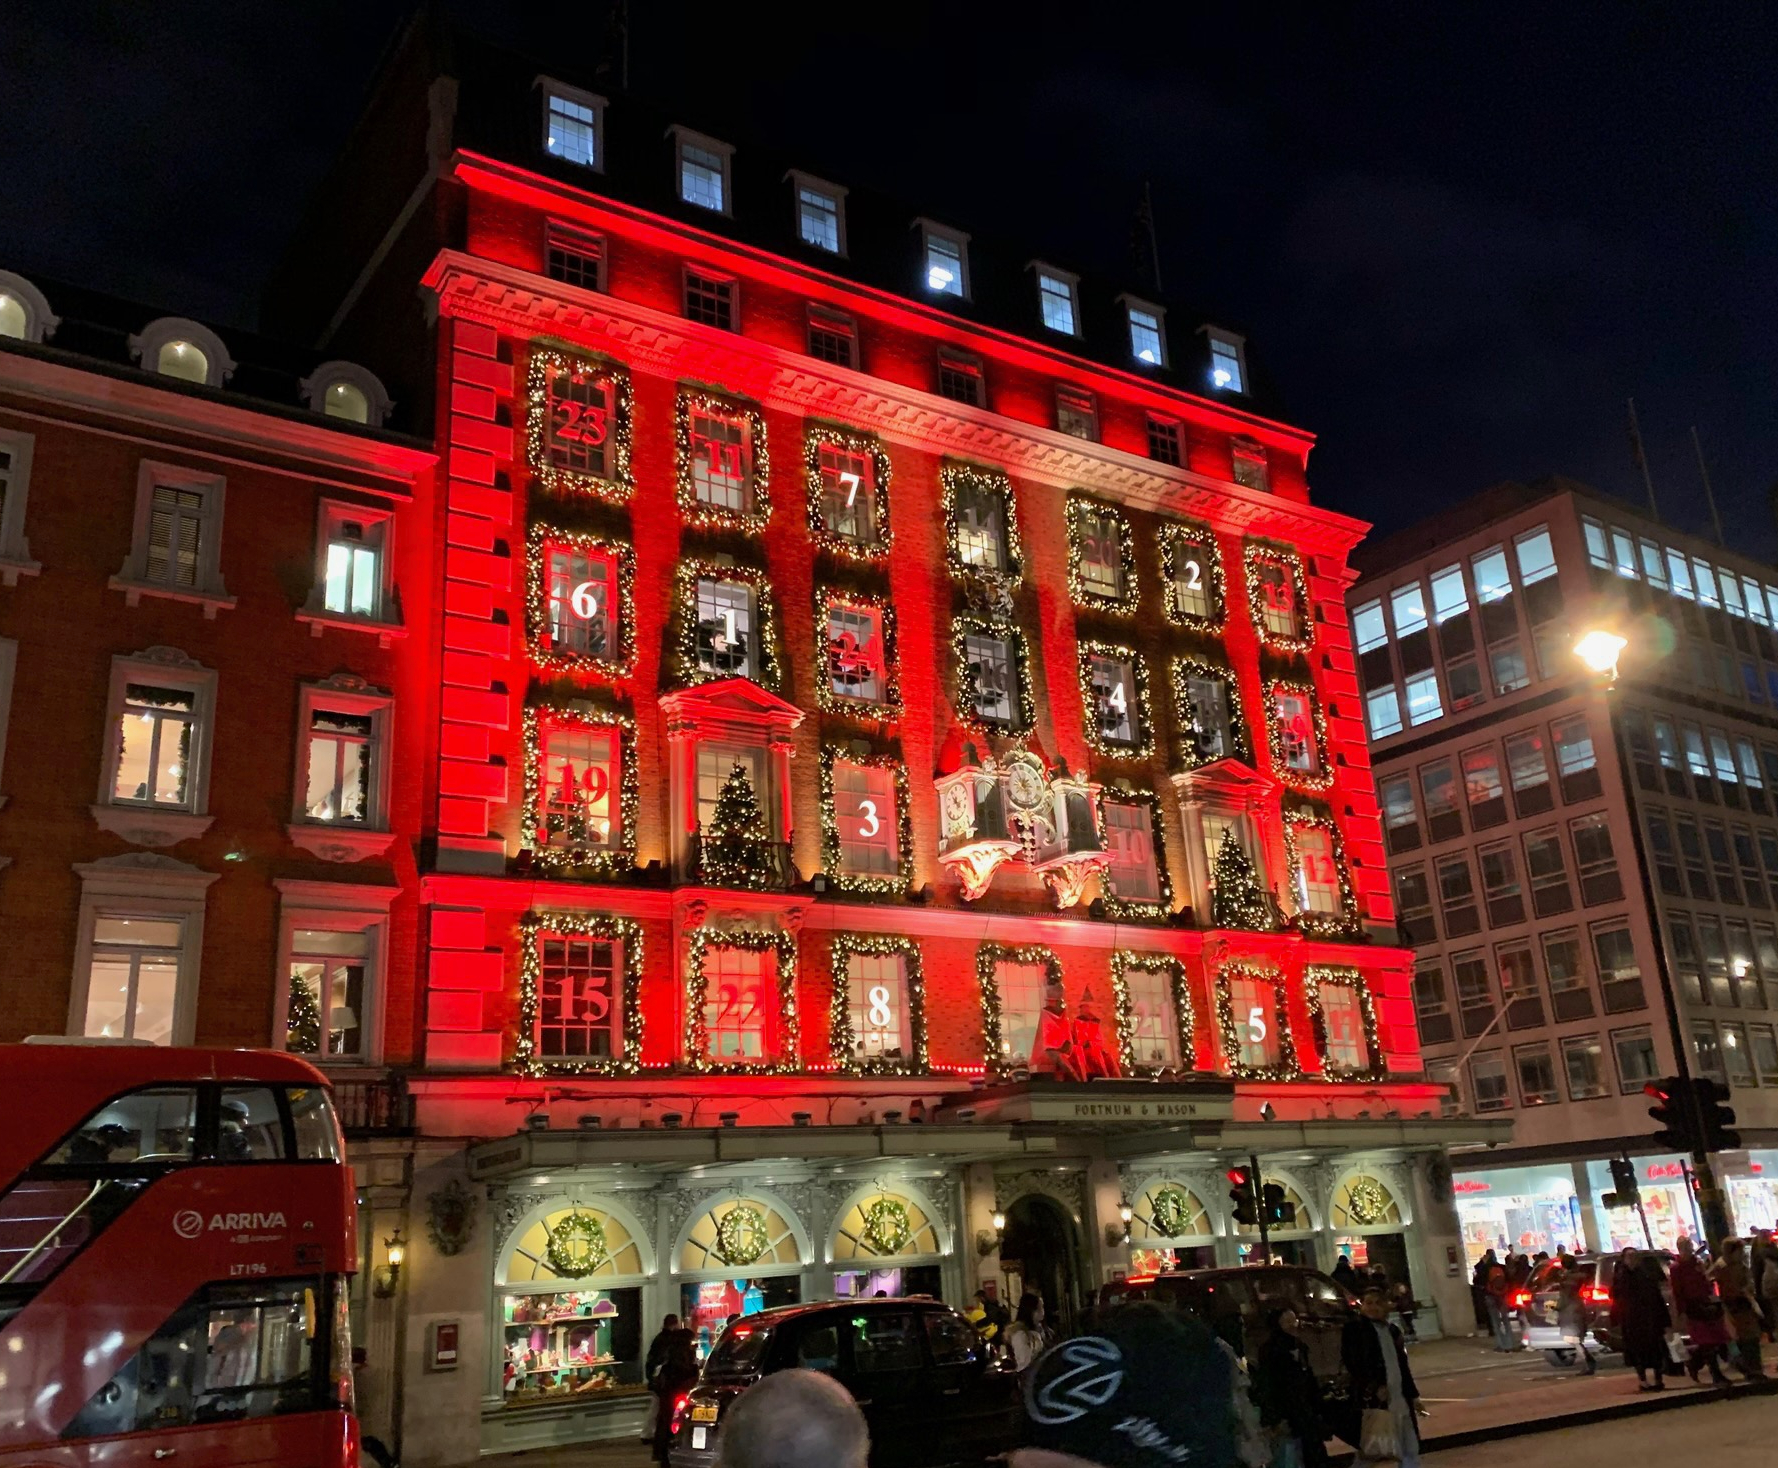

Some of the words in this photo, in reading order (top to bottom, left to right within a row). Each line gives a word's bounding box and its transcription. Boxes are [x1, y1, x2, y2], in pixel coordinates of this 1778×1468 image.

[556, 401, 608, 445] 23
[705, 441, 745, 481] 11
[840, 472, 861, 508] 7
[964, 507, 997, 540] 14
[1185, 560, 1203, 591] 2
[571, 581, 598, 620] 6
[1264, 582, 1293, 613] 13
[719, 609, 740, 646] 1
[837, 630, 879, 672] 24
[979, 660, 1008, 692] 16
[1109, 683, 1127, 714] 4
[556, 764, 609, 805] 19
[858, 800, 880, 837] 3
[1116, 830, 1144, 864] 10
[1305, 852, 1333, 884] 12
[554, 976, 609, 1021] 15
[717, 984, 765, 1024] 22
[868, 986, 892, 1026] 8
[1248, 1008, 1266, 1043] 5
[1075, 1104, 1131, 1116] FORTNUM
[1141, 1105, 1149, 1116] &
[1157, 1104, 1197, 1116] MASON
[207, 1211, 287, 1231] ARRIVA
[230, 1263, 267, 1276] LT196
